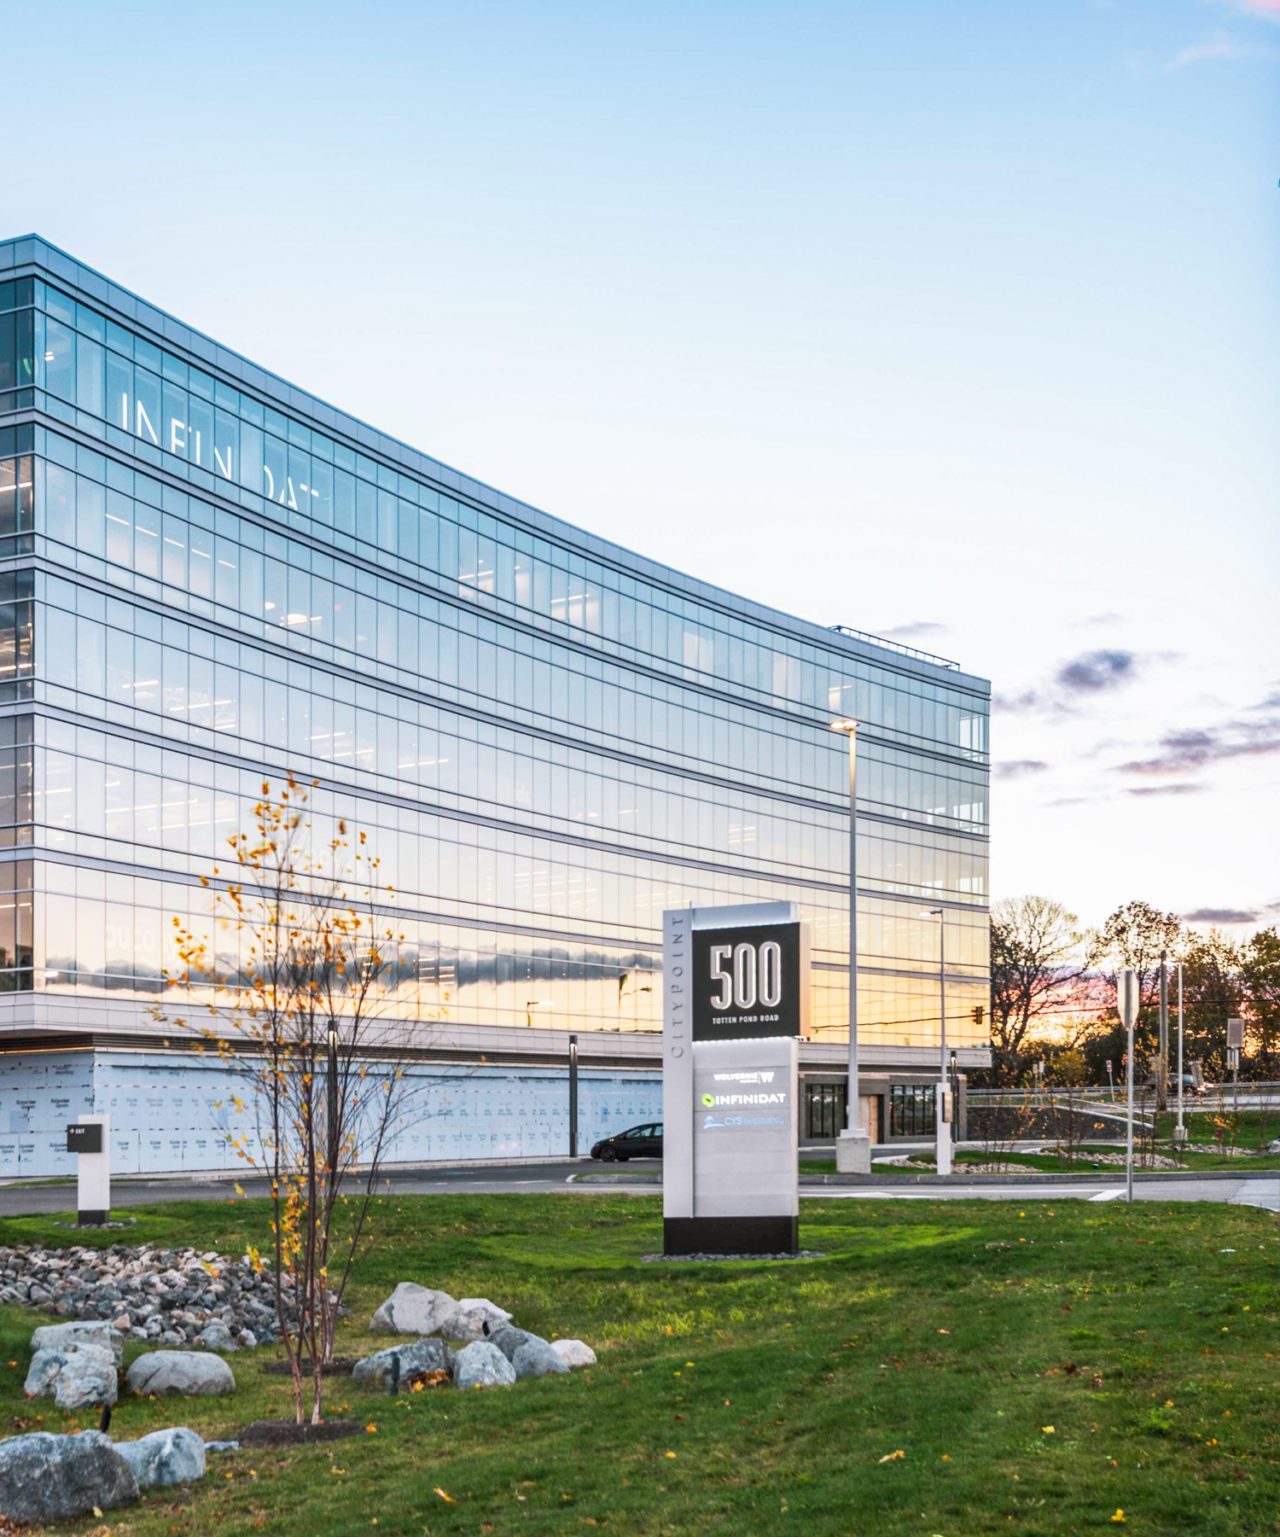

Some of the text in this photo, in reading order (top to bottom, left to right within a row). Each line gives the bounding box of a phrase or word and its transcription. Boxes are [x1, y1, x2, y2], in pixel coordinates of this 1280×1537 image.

[671, 917, 684, 1059] CITYPOINT
[710, 941, 782, 1010] 500
[712, 1014, 780, 1024] TOTTEN POND ROAD
[715, 1093, 786, 1105] INFINIDAT
